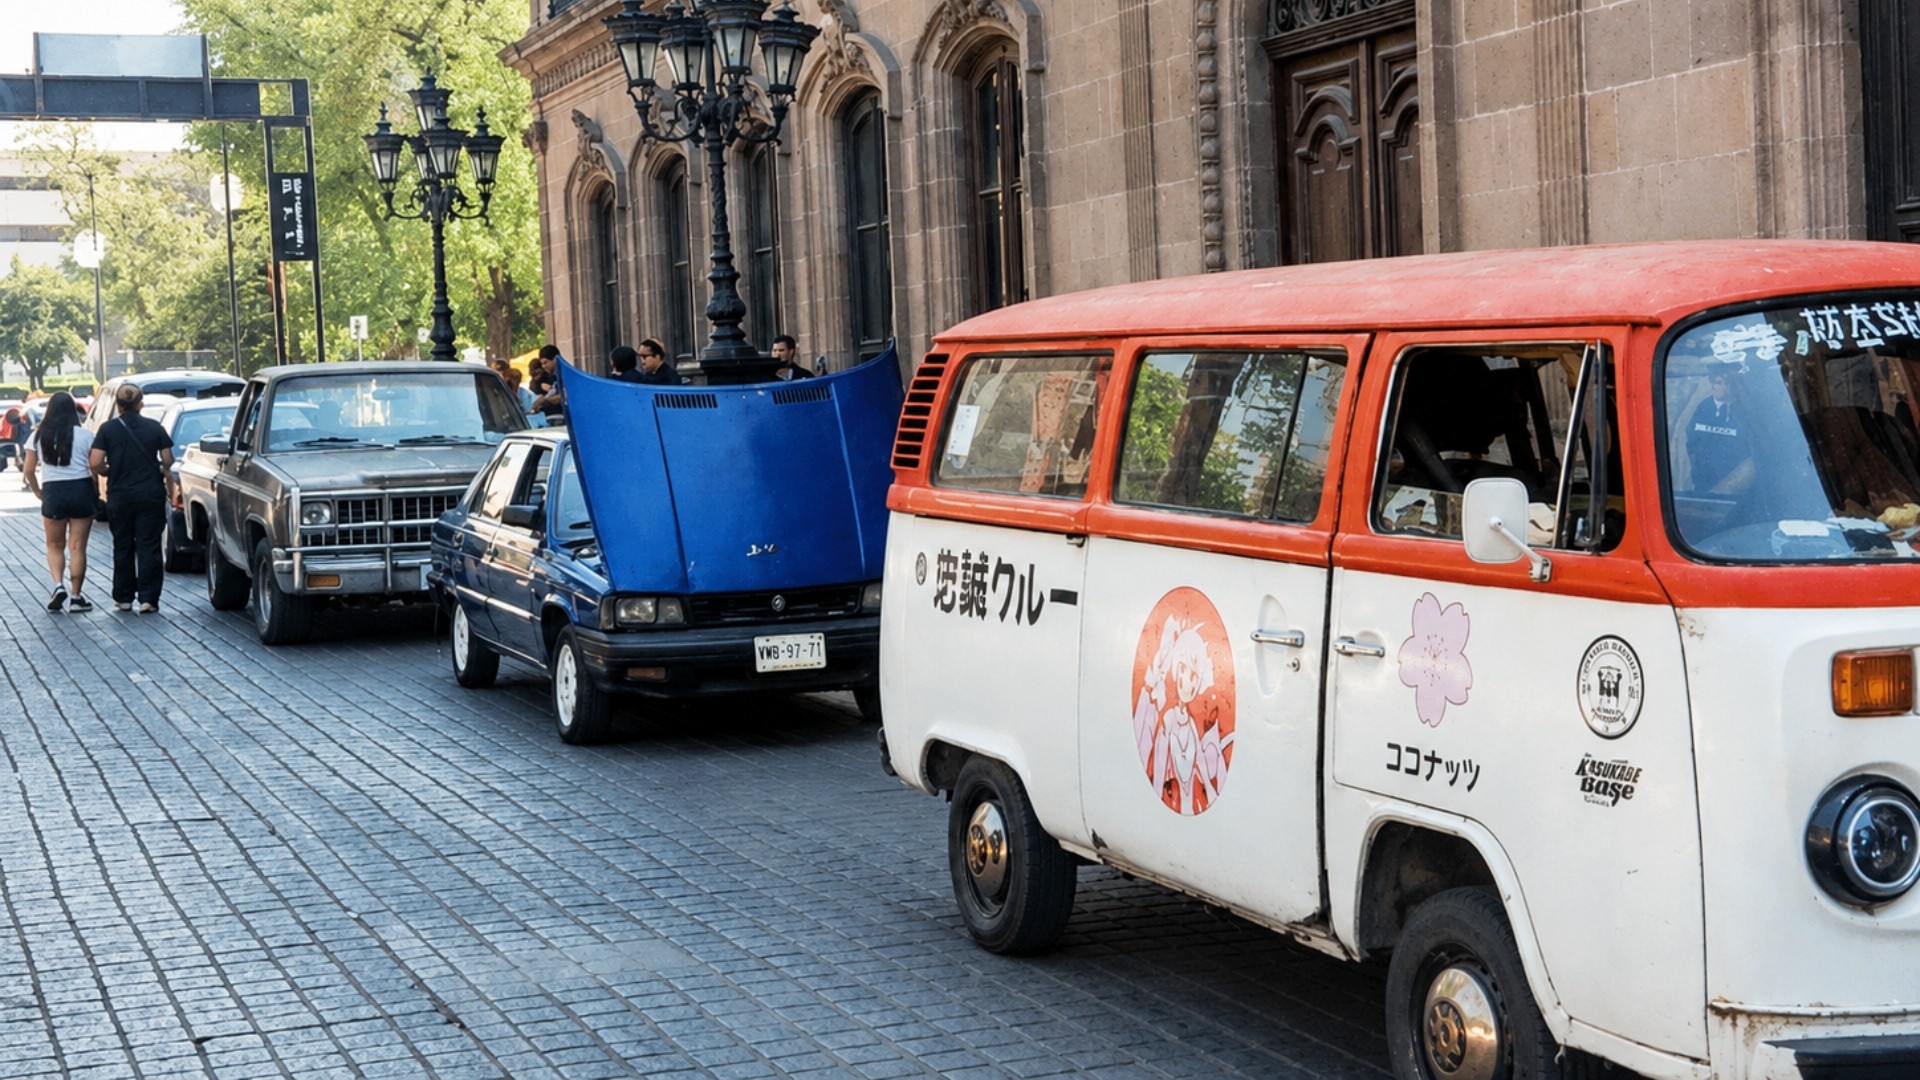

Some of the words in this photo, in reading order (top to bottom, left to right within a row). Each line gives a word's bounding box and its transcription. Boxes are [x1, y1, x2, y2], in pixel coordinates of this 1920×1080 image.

[1386, 742, 1481, 793] ココナッツ
